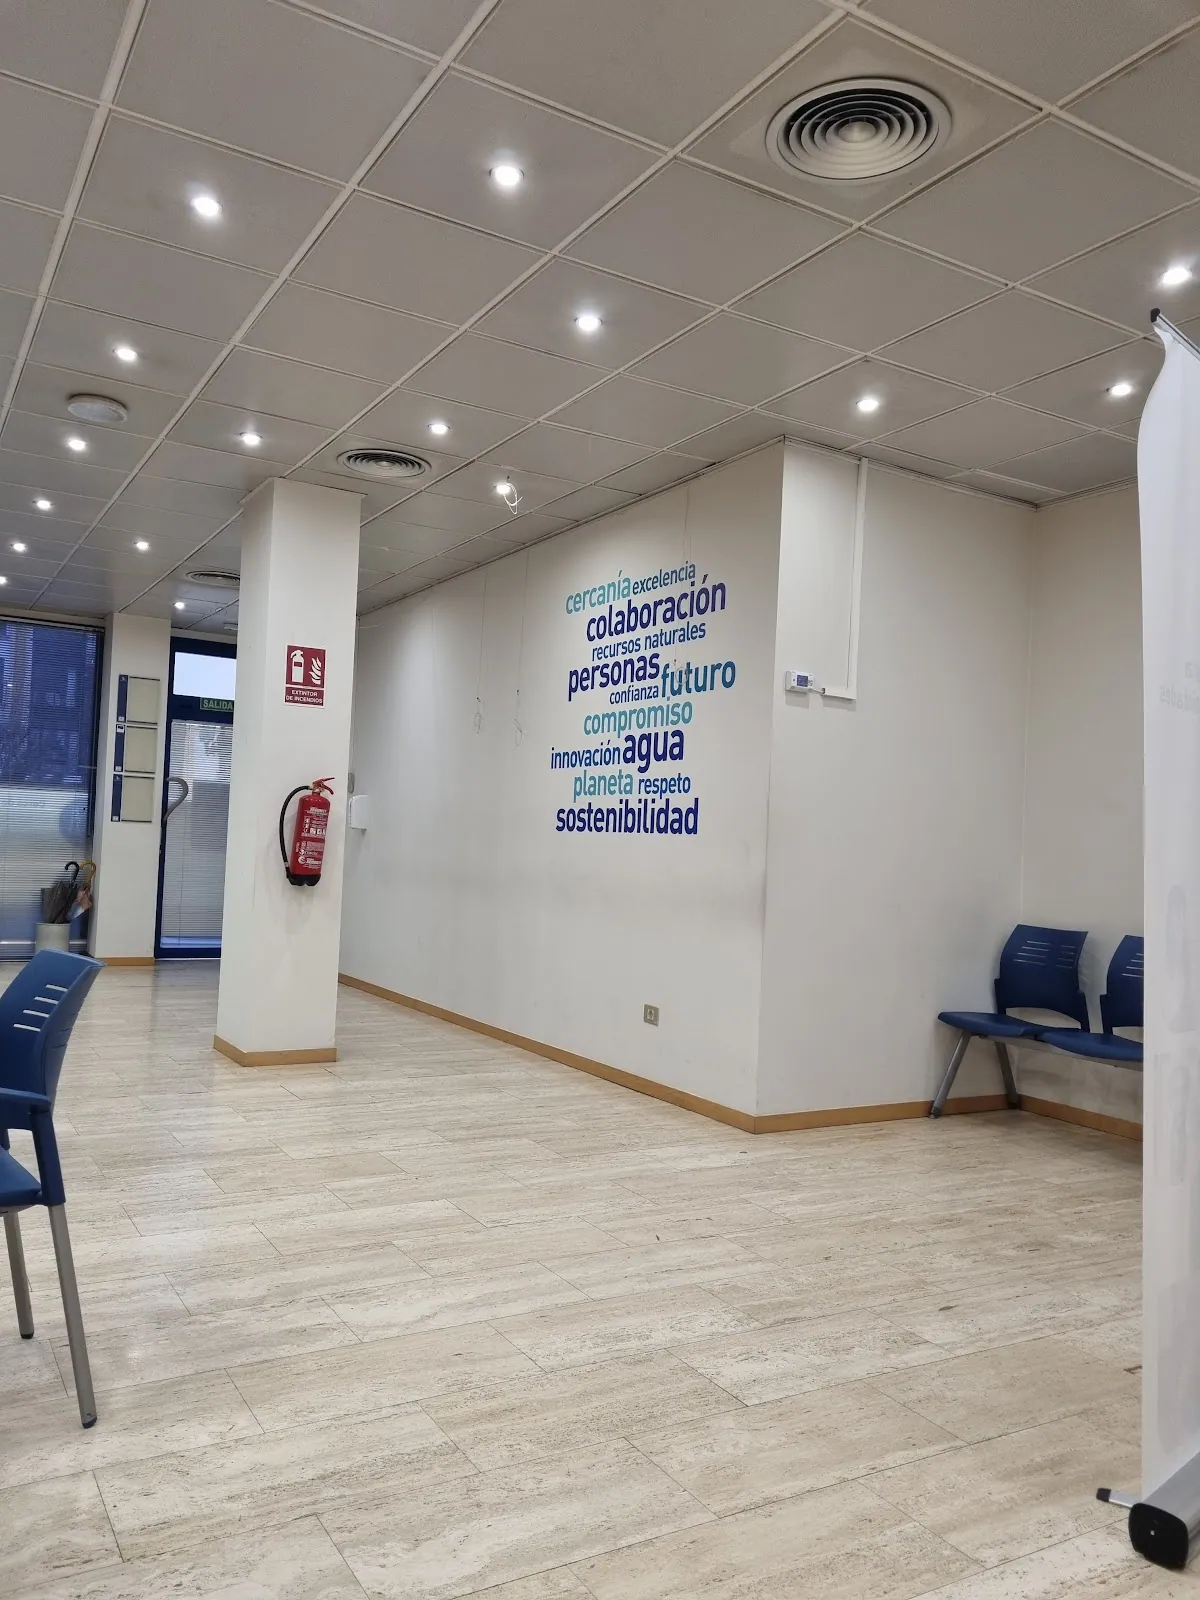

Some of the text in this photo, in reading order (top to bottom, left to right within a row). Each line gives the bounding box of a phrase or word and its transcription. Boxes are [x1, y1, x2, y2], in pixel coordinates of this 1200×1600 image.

[565, 561, 696, 614] cercanía excelencia
[586, 574, 726, 642] colaboración
[592, 621, 706, 661] recursos naturales
[568, 652, 736, 701] personas futuro
[609, 684, 659, 704] confianza
[203, 699, 233, 710] SALIDA
[294, 696, 323, 704] INCENDIOS
[583, 696, 693, 738] compromiso
[550, 729, 685, 773] innovación agua
[573, 769, 691, 803] planeta respeto
[555, 797, 699, 835] sostenibilidad
